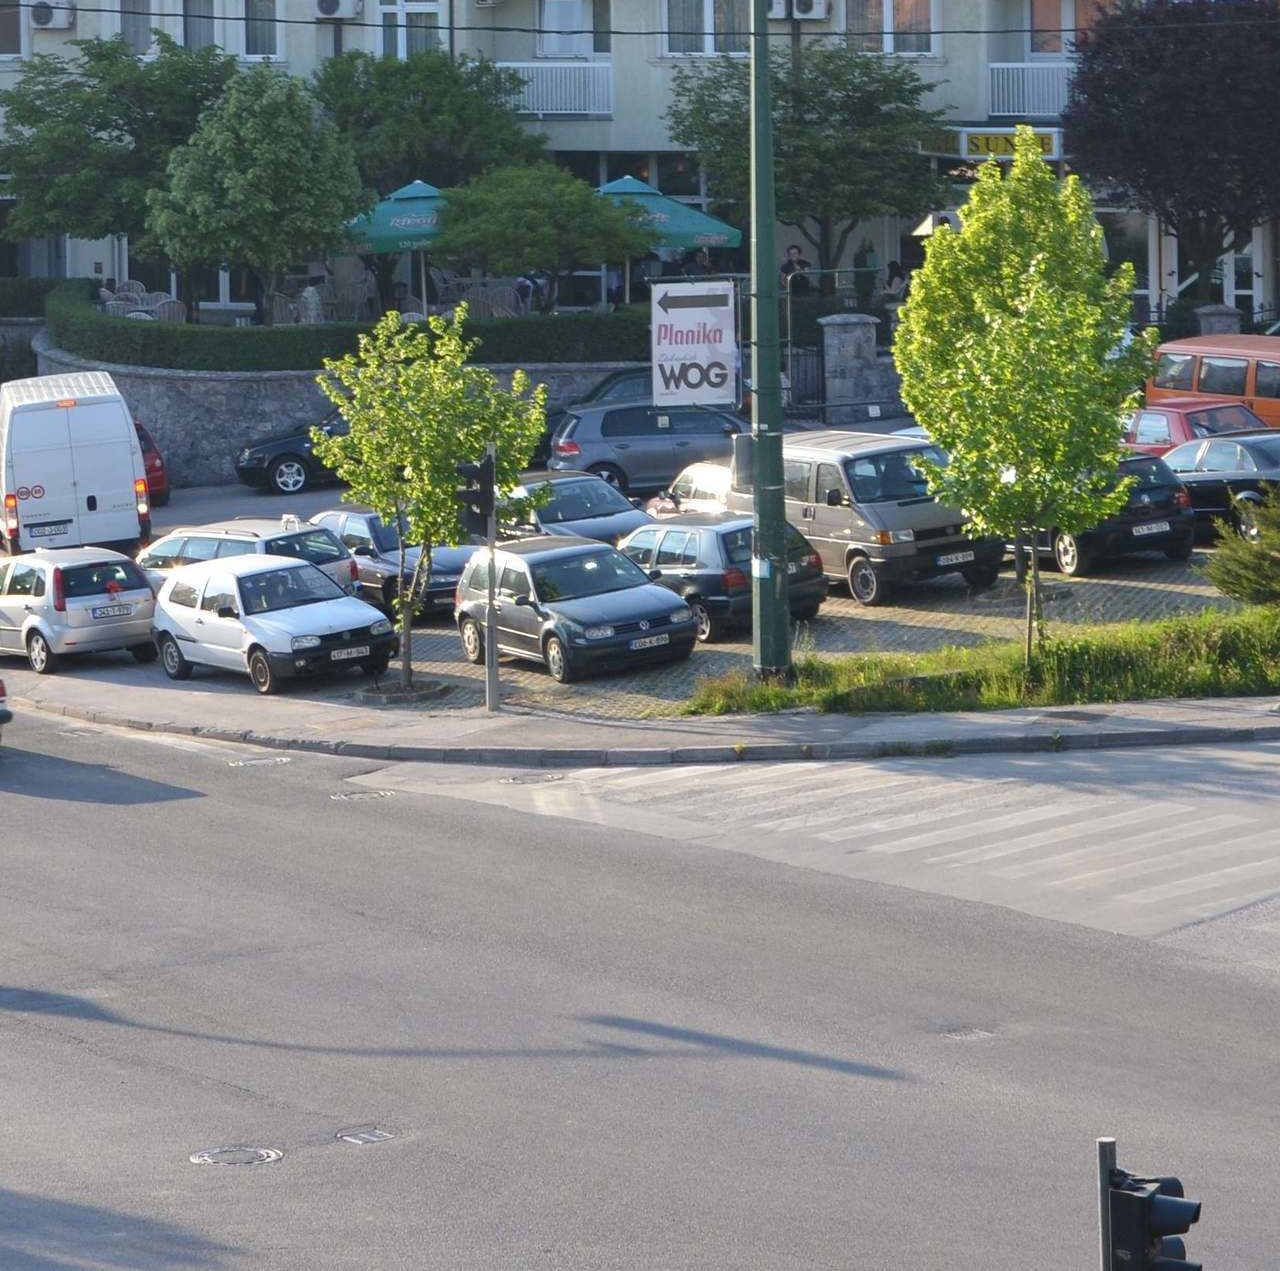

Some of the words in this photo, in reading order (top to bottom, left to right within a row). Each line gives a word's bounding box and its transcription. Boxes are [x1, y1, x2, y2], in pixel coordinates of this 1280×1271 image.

[970, 136, 1052, 153] SUNE
[657, 322, 723, 346] Planika
[658, 361, 729, 390] WOG
